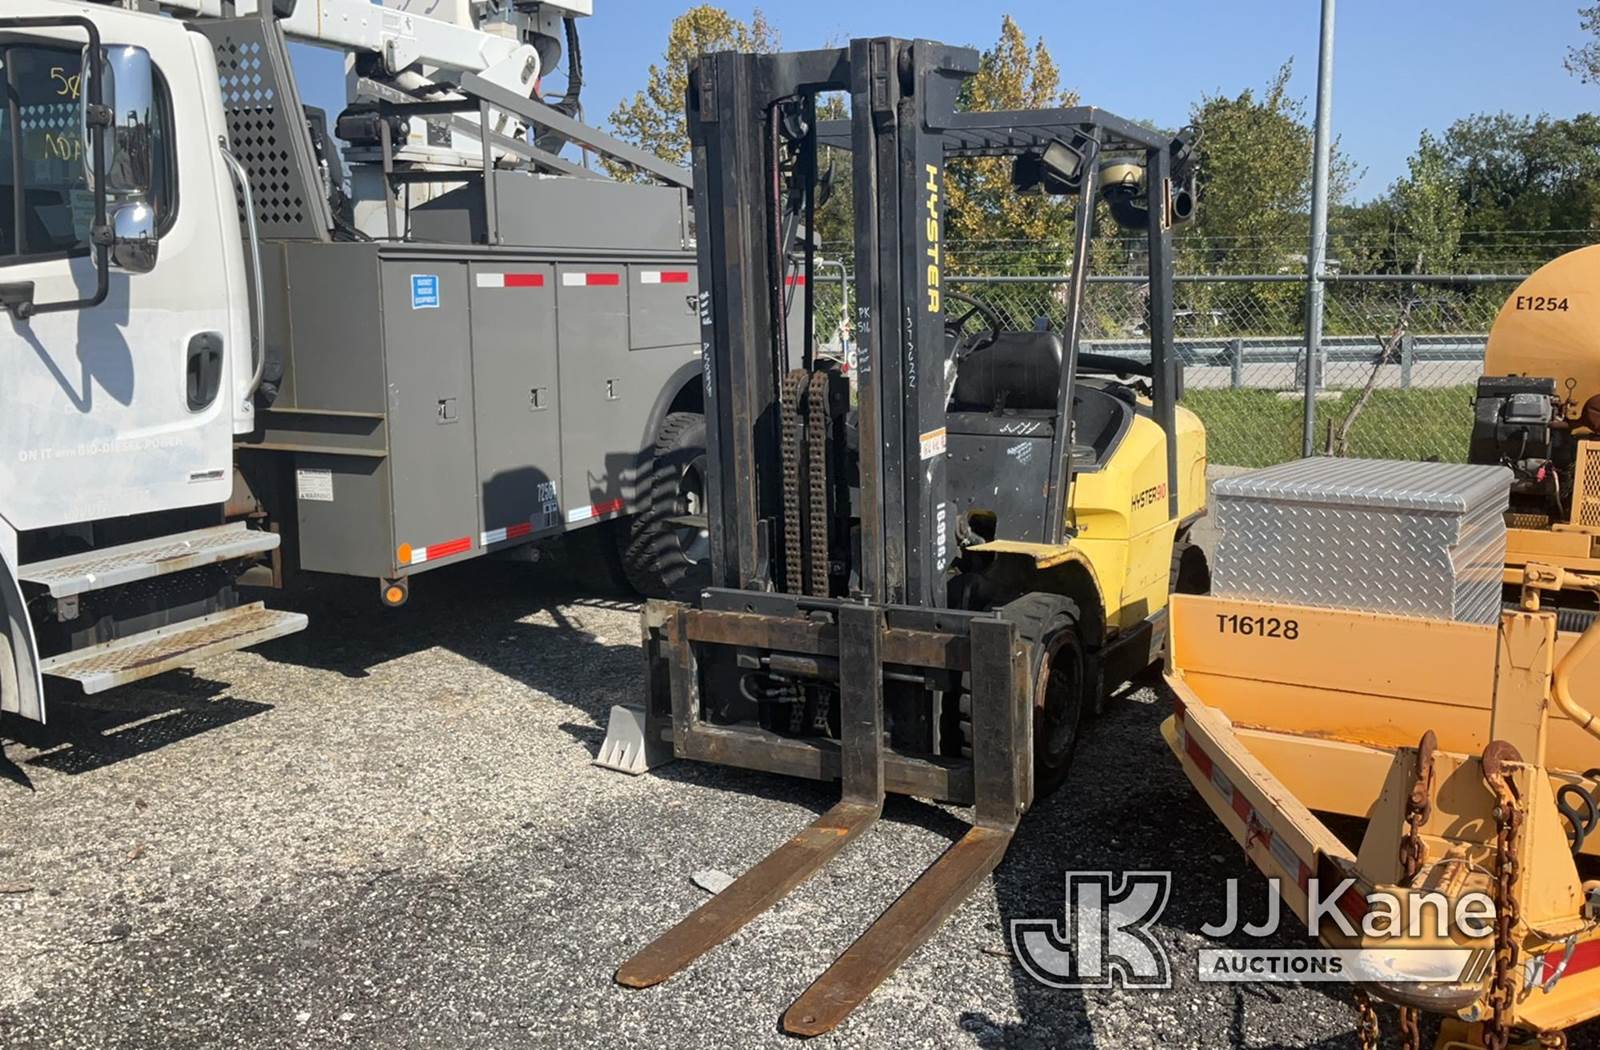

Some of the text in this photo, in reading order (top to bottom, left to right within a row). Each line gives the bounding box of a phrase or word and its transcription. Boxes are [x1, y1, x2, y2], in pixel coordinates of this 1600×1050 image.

[926, 163, 940, 313] HYSTER
[1516, 296, 1569, 312] E1254
[1131, 487, 1156, 512] HYSTER
[1216, 614, 1299, 640] T16128
